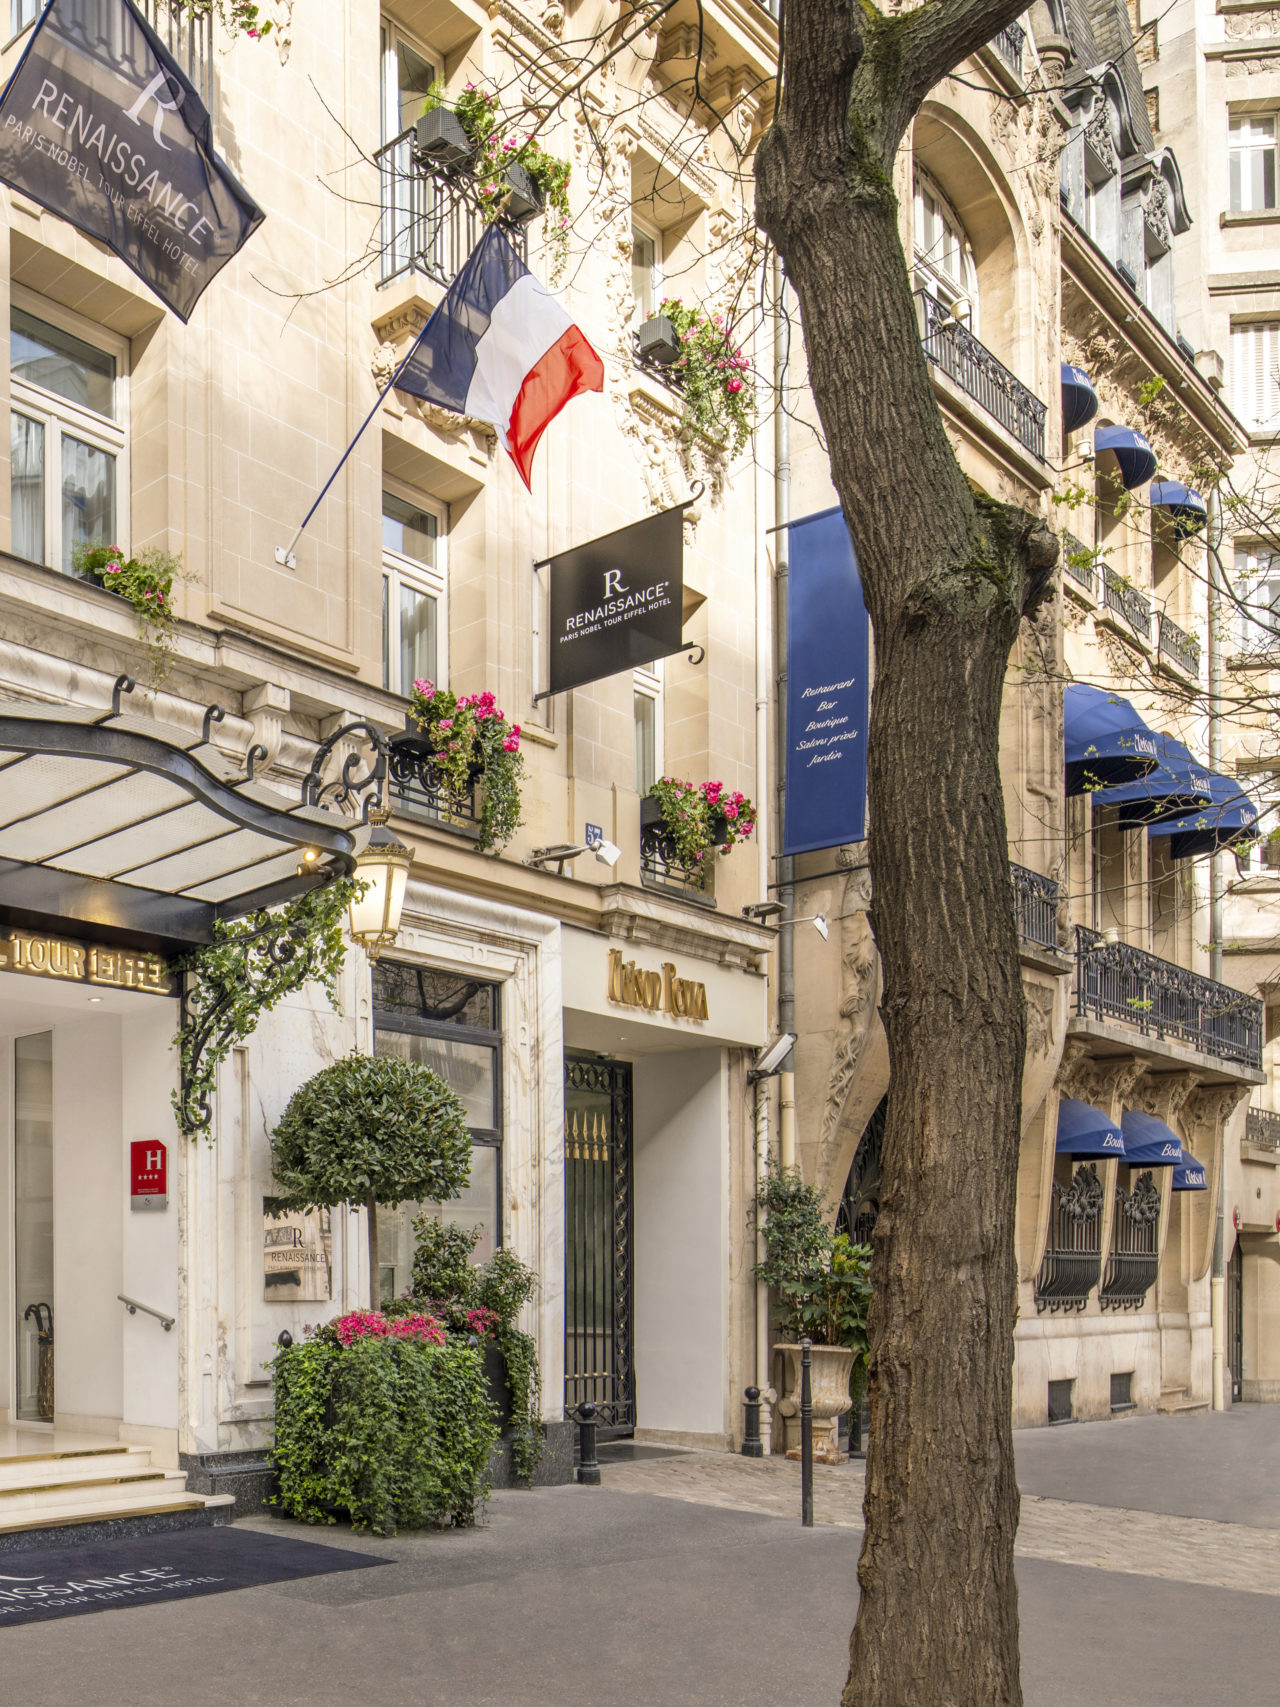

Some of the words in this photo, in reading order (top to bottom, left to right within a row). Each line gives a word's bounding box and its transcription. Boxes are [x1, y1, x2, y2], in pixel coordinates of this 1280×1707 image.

[123, 64, 187, 151] R
[32, 79, 214, 245] RENAISSANCE
[5, 114, 44, 150] PARIS
[47, 144, 91, 183] NOBEL
[97, 172, 125, 212] TOUR
[127, 204, 160, 244] EIFFEL
[162, 240, 200, 278] HOTEL
[603, 569, 630, 599] R
[566, 583, 665, 631] RENAISSANCE
[560, 631, 579, 643] PARIS
[580, 623, 602, 636] NOBEL
[604, 616, 622, 627] TOUR
[624, 607, 647, 620] EIFFEL
[648, 598, 671, 611] HOTEL
[801, 678, 855, 698] Restaurant
[816, 701, 838, 712] Bar
[805, 716, 849, 732] Boutique
[796, 738, 828, 750] Salons
[806, 750, 842, 768] Jardin
[587, 825, 601, 845] 57
[11, 932, 87, 977] TOUR
[145, 1150, 163, 1170] H
[292, 1228, 305, 1248] R
[272, 1252, 326, 1263] RENAISSANCE
[33, 1594, 95, 1608] TOUR
[95, 1586, 162, 1600] EIFFEL
[161, 1576, 225, 1589] HOTEL
